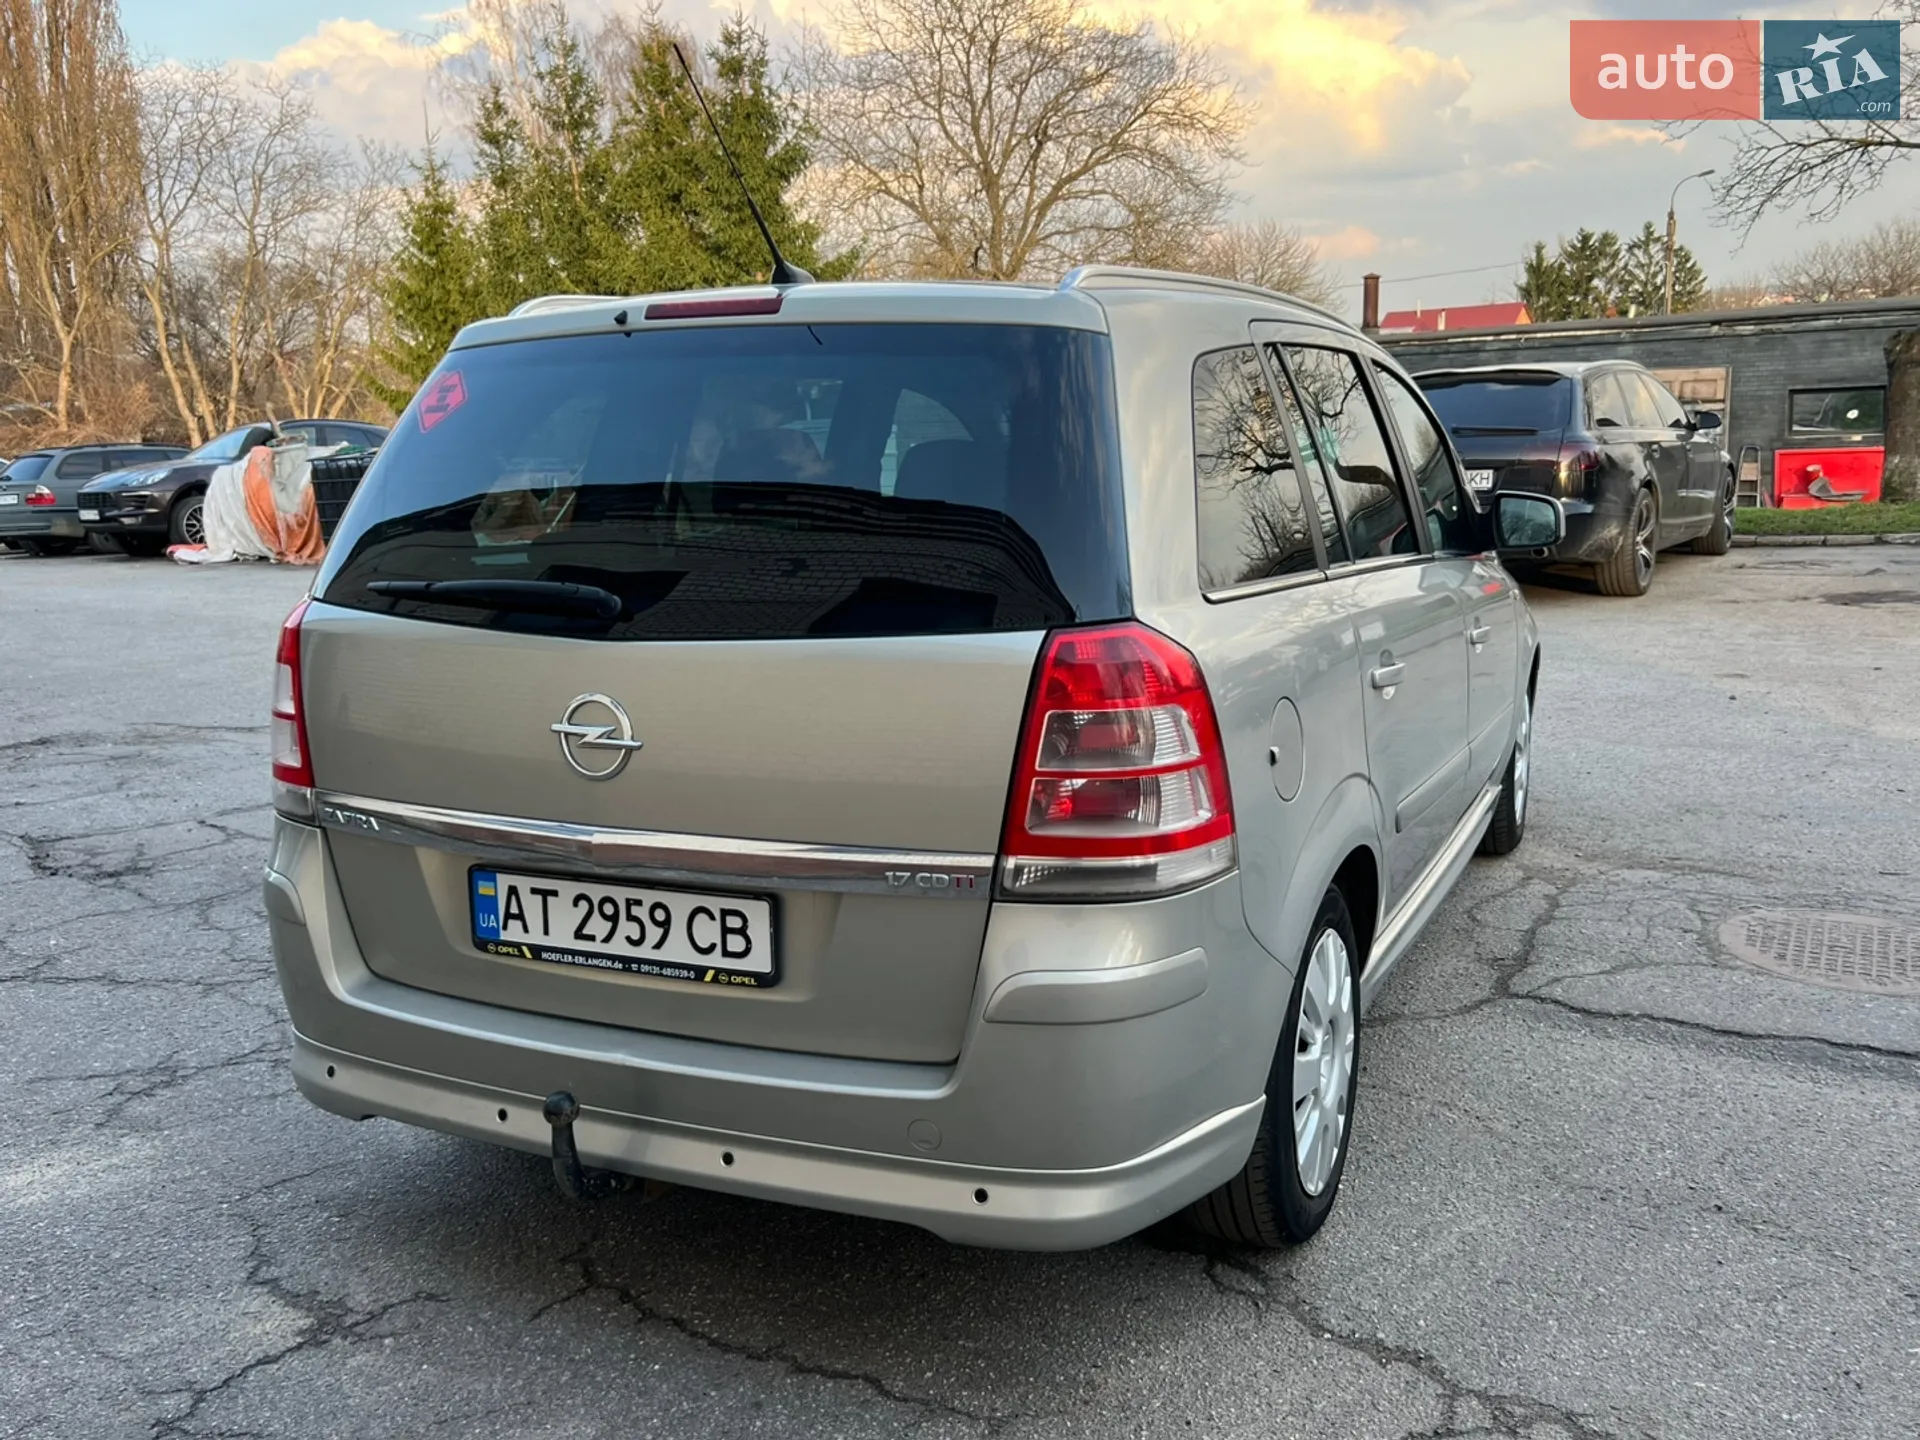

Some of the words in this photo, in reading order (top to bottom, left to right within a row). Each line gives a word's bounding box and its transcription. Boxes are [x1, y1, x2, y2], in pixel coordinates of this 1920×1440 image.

[915, 872, 975, 891] CDTI
[479, 913, 498, 929] UA
[501, 884, 559, 937] AT
[572, 892, 673, 951] 2959
[686, 905, 753, 960] CB
[497, 945, 520, 956] OPEL
[731, 974, 758, 986] OPEL
